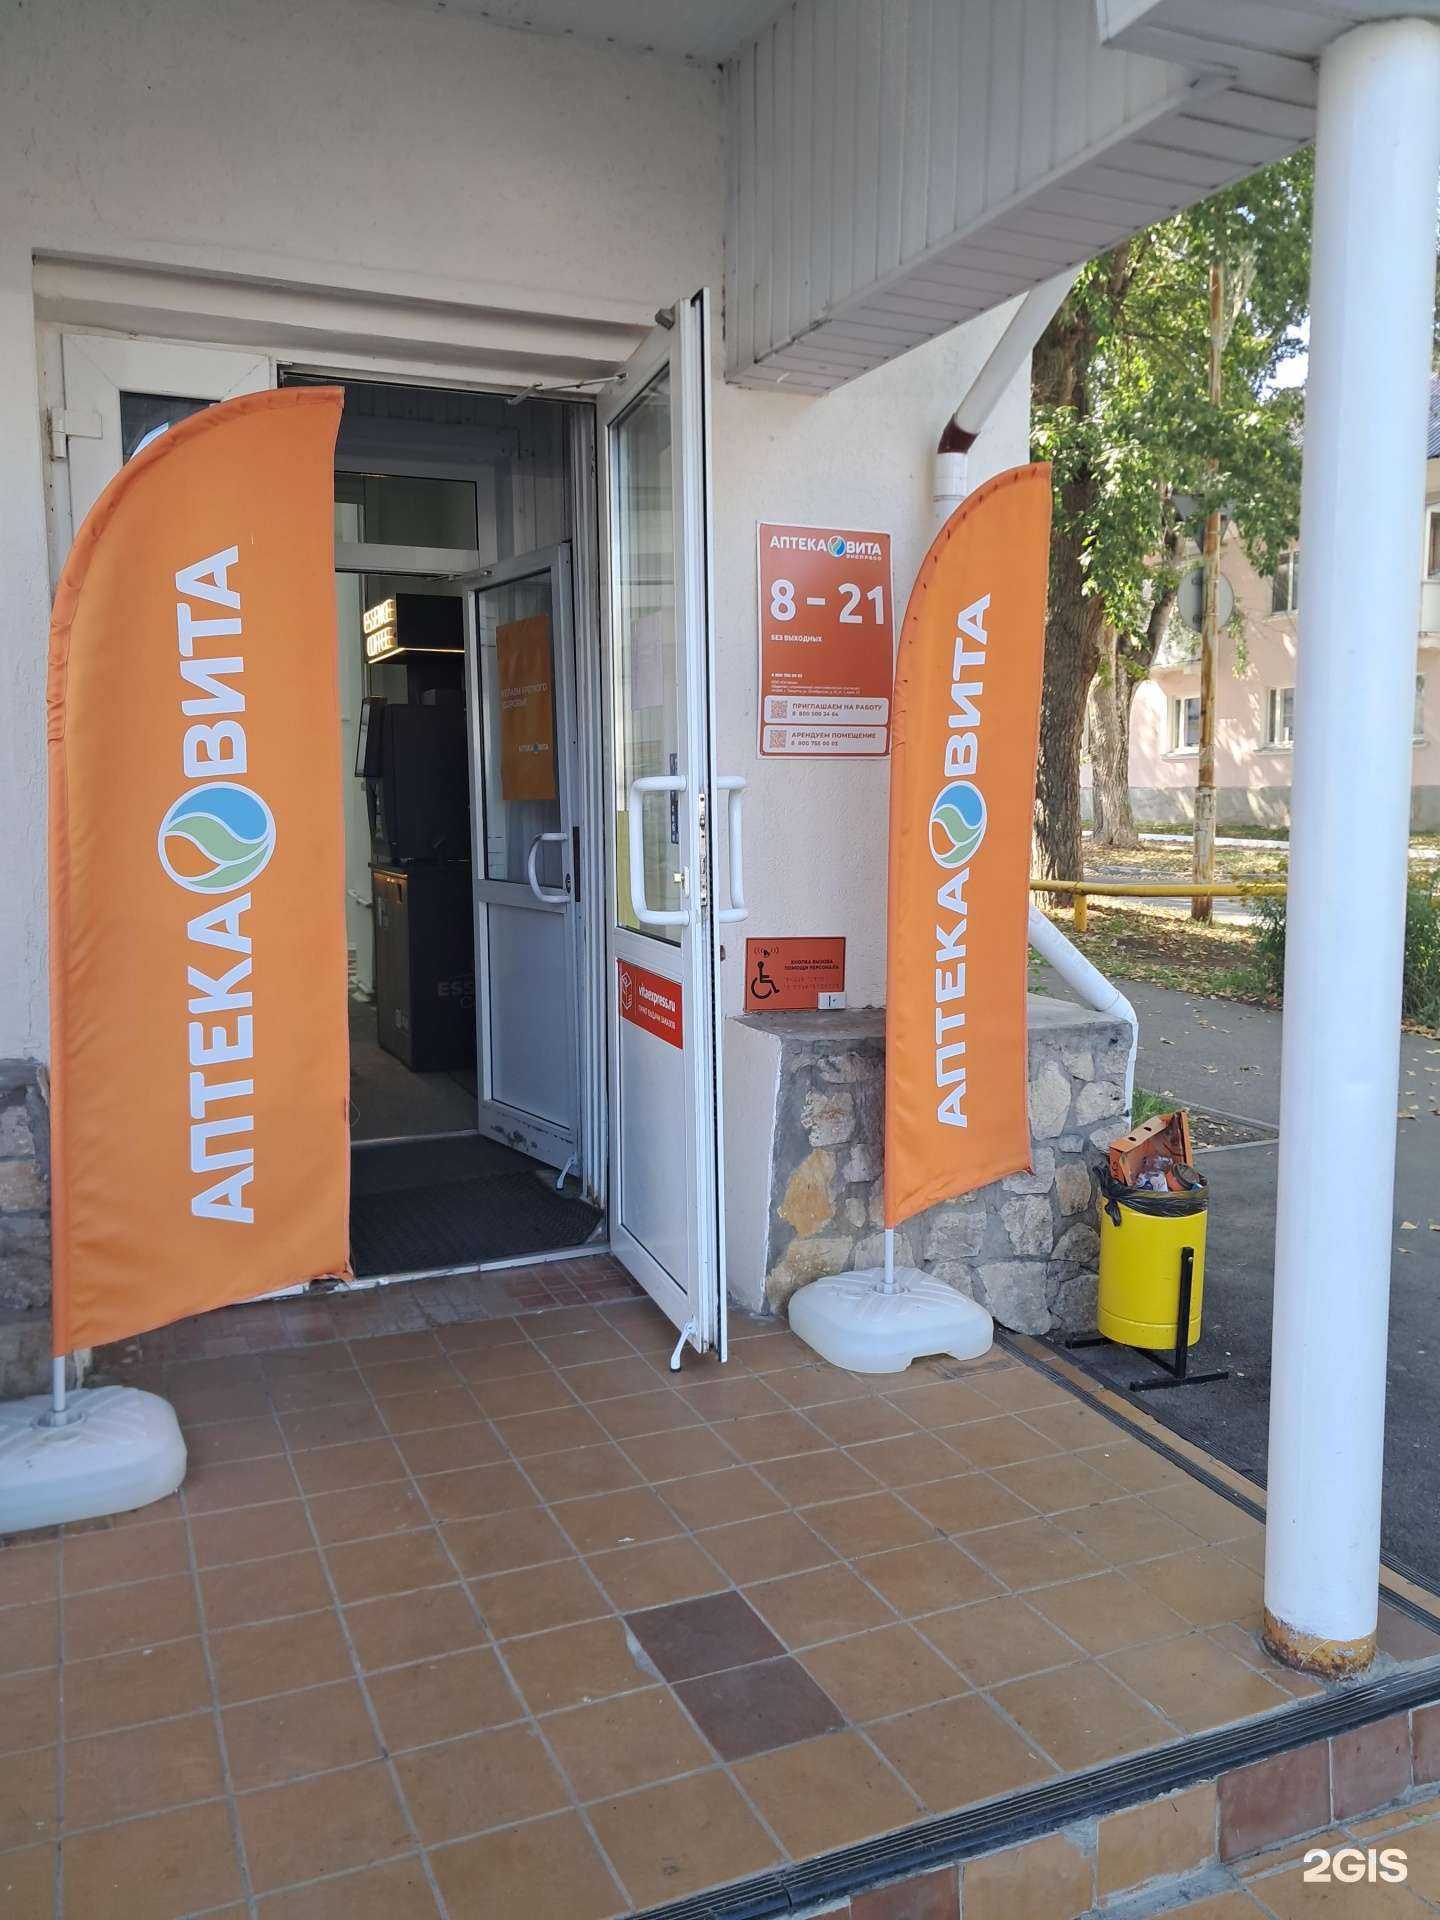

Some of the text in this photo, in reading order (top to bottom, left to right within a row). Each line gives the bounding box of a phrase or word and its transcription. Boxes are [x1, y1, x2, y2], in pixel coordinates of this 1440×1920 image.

[770, 535, 882, 555] АПТЕКА ВИТА
[770, 578, 797, 622] 8
[838, 582, 885, 625] 21
[771, 633, 823, 643] БЕЗ ВЫХОДНЫХ
[792, 702, 882, 711] ПРИГЛАШАЕМ НА РАБОТУ
[791, 732, 877, 740] АРЕНДУЕМ ПОМЕЩЕНИЕ
[936, 592, 992, 1129] АПТЕКА ВИТА
[176, 544, 255, 1225] АПТЕКА ВИТА
[639, 983, 676, 1013] vitaexpress.ru
